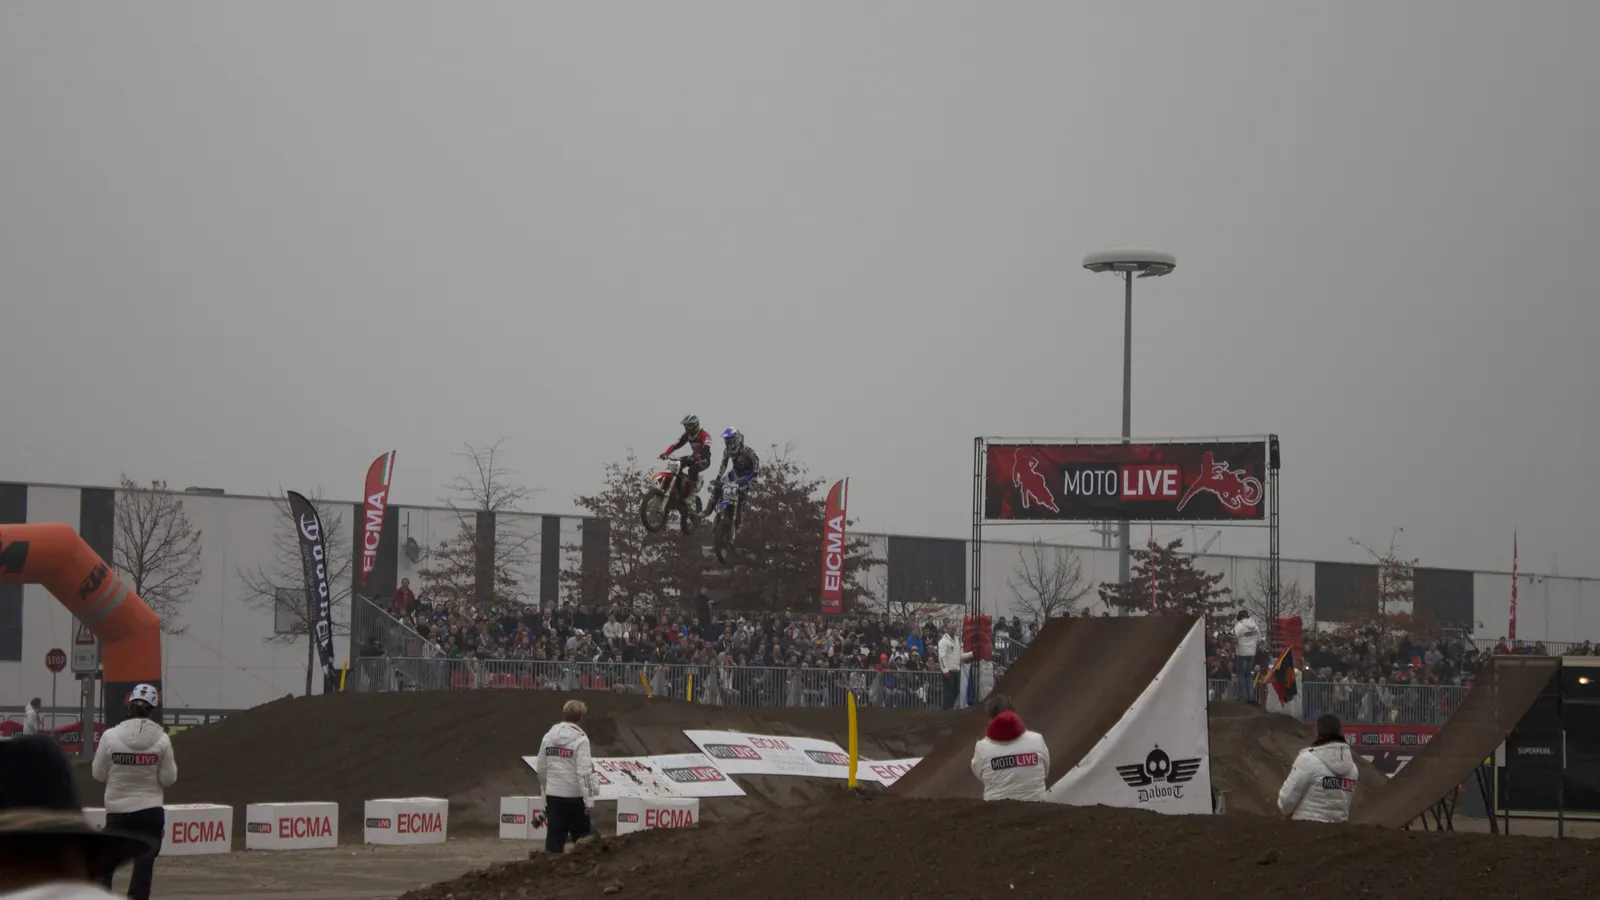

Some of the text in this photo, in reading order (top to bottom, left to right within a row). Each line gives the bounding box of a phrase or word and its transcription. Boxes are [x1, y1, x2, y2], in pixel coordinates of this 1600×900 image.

[1064, 470, 1178, 496] MOTO LIVE
[363, 490, 385, 572] EICMA
[825, 515, 843, 592] EICMA
[78, 564, 109, 600] KTM
[47, 656, 66, 665] STOP
[59, 731, 79, 742] MOTO
[1362, 734, 1379, 744] MOTO
[1380, 733, 1396, 744] LIVE
[1401, 734, 1417, 745] MOTO
[705, 746, 760, 758] MOTO LIVE
[747, 737, 796, 752] EICMA
[113, 754, 158, 766] MOTO LIVE
[992, 754, 1038, 769] MOTO LIVE
[665, 767, 724, 781] MOTO LIVE
[397, 812, 443, 834] EICMA
[513, 815, 525, 823] LIVE
[627, 814, 638, 823] LIVE
[645, 808, 694, 829] EICMA
[172, 820, 227, 844] EICMA
[259, 824, 271, 833] LIVE
[279, 816, 333, 838] EICMA
